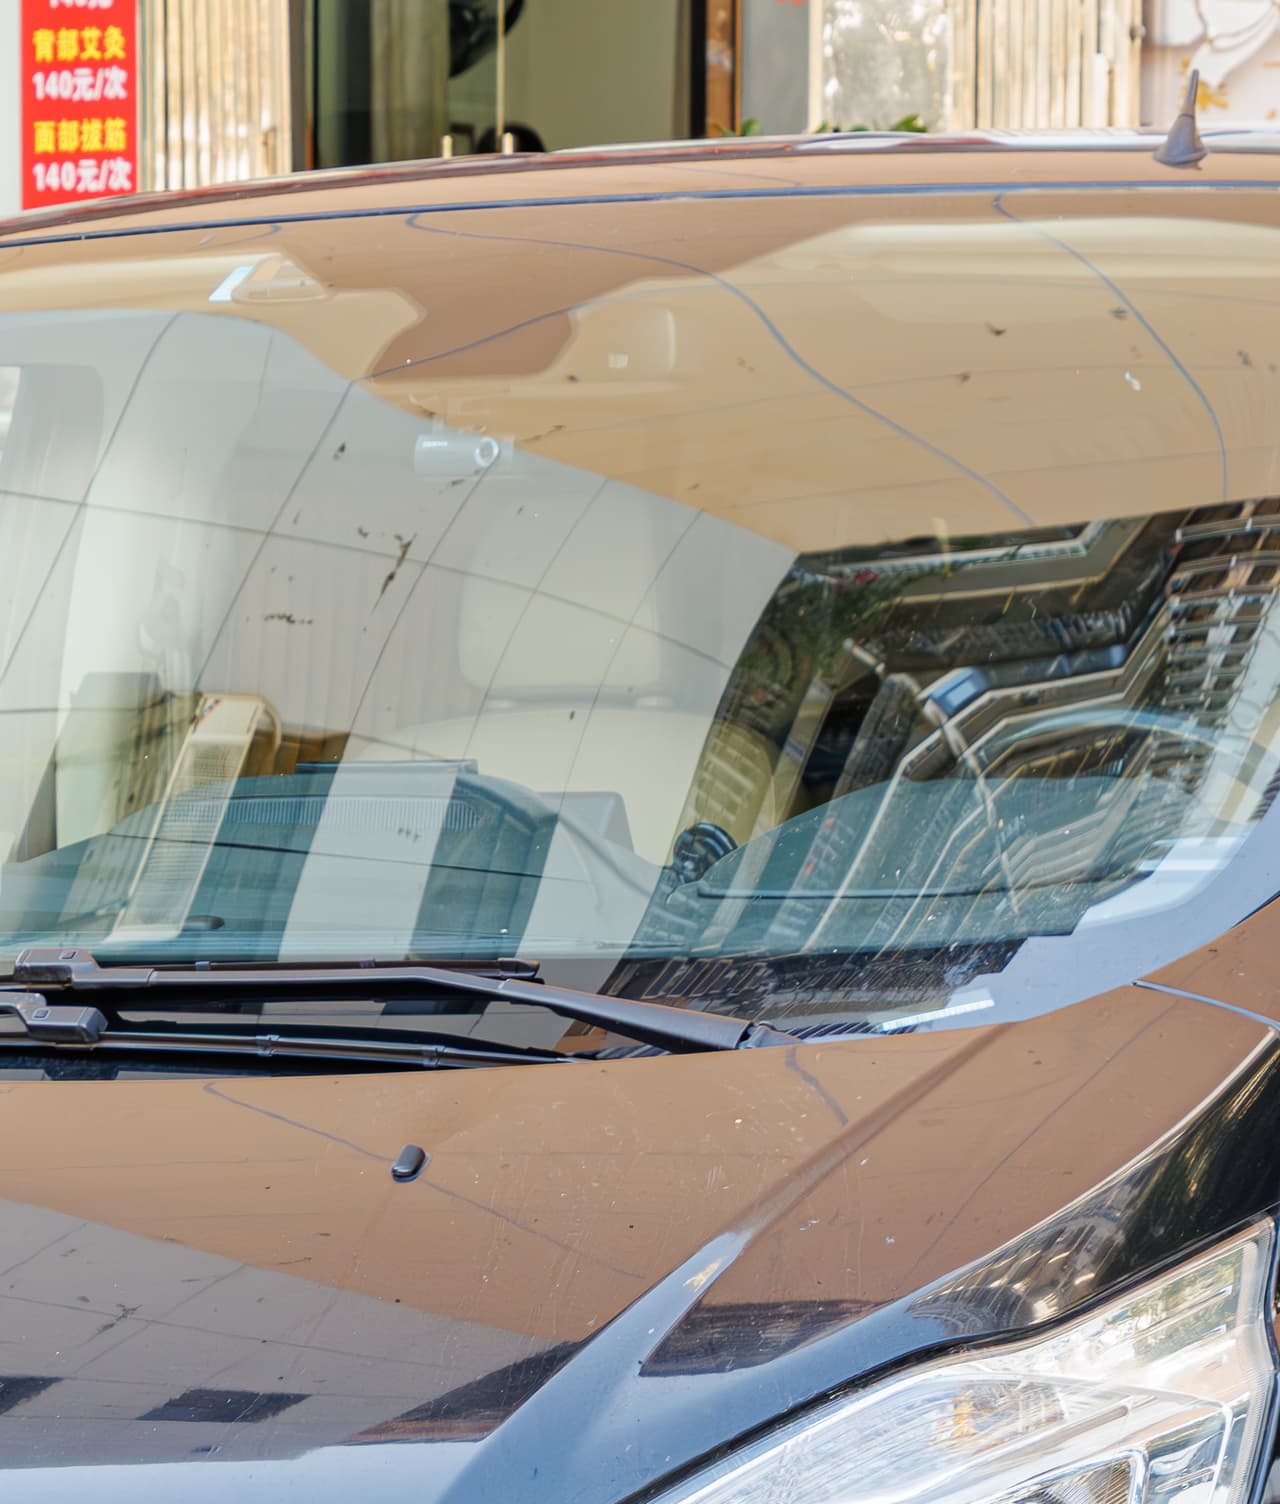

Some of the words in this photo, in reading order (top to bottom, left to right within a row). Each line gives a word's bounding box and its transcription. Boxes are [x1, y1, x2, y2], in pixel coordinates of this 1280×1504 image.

[32, 25, 126, 63] 背部艾灸
[32, 65, 128, 101] 140元/次
[32, 156, 132, 193] 140元/次
